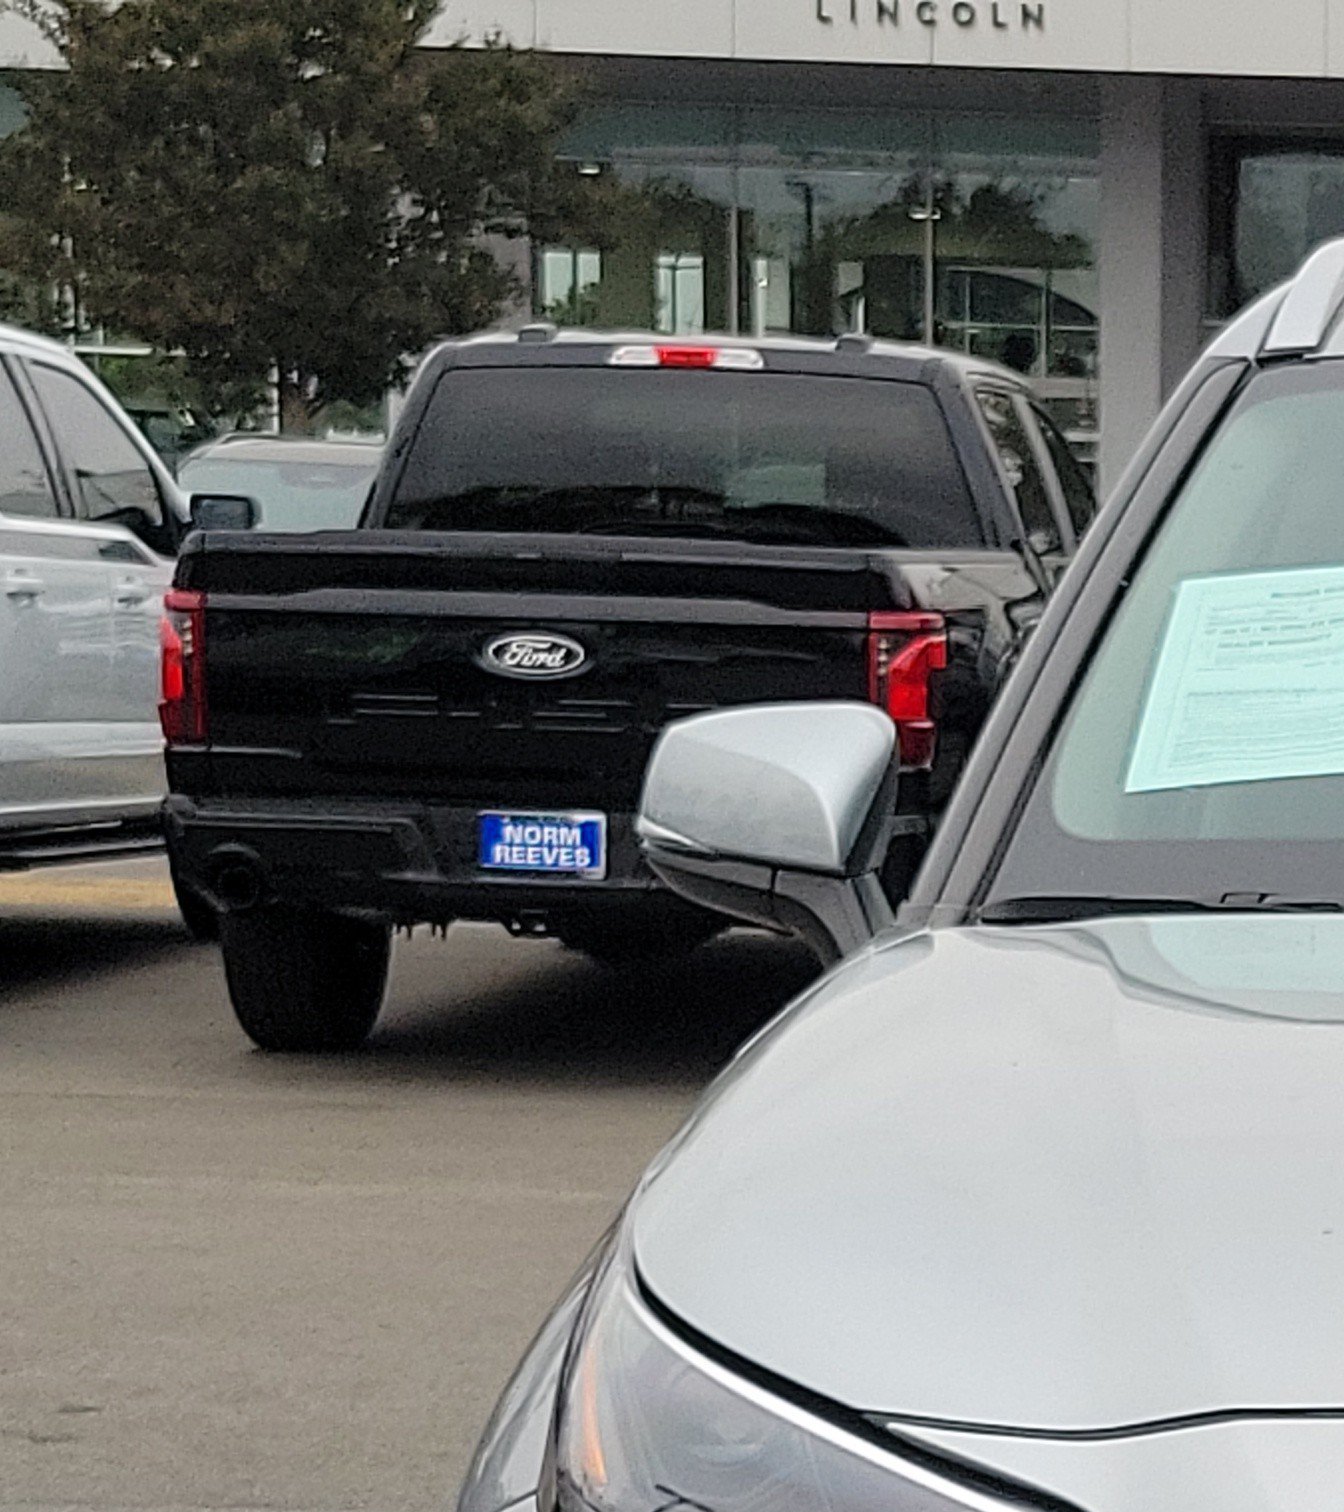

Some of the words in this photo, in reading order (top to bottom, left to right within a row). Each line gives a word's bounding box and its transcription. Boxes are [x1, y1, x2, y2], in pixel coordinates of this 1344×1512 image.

[816, 0, 1044, 29] LINCOLN
[503, 641, 566, 668] Ford
[503, 824, 581, 846] NORM
[493, 845, 591, 867] REEVES
